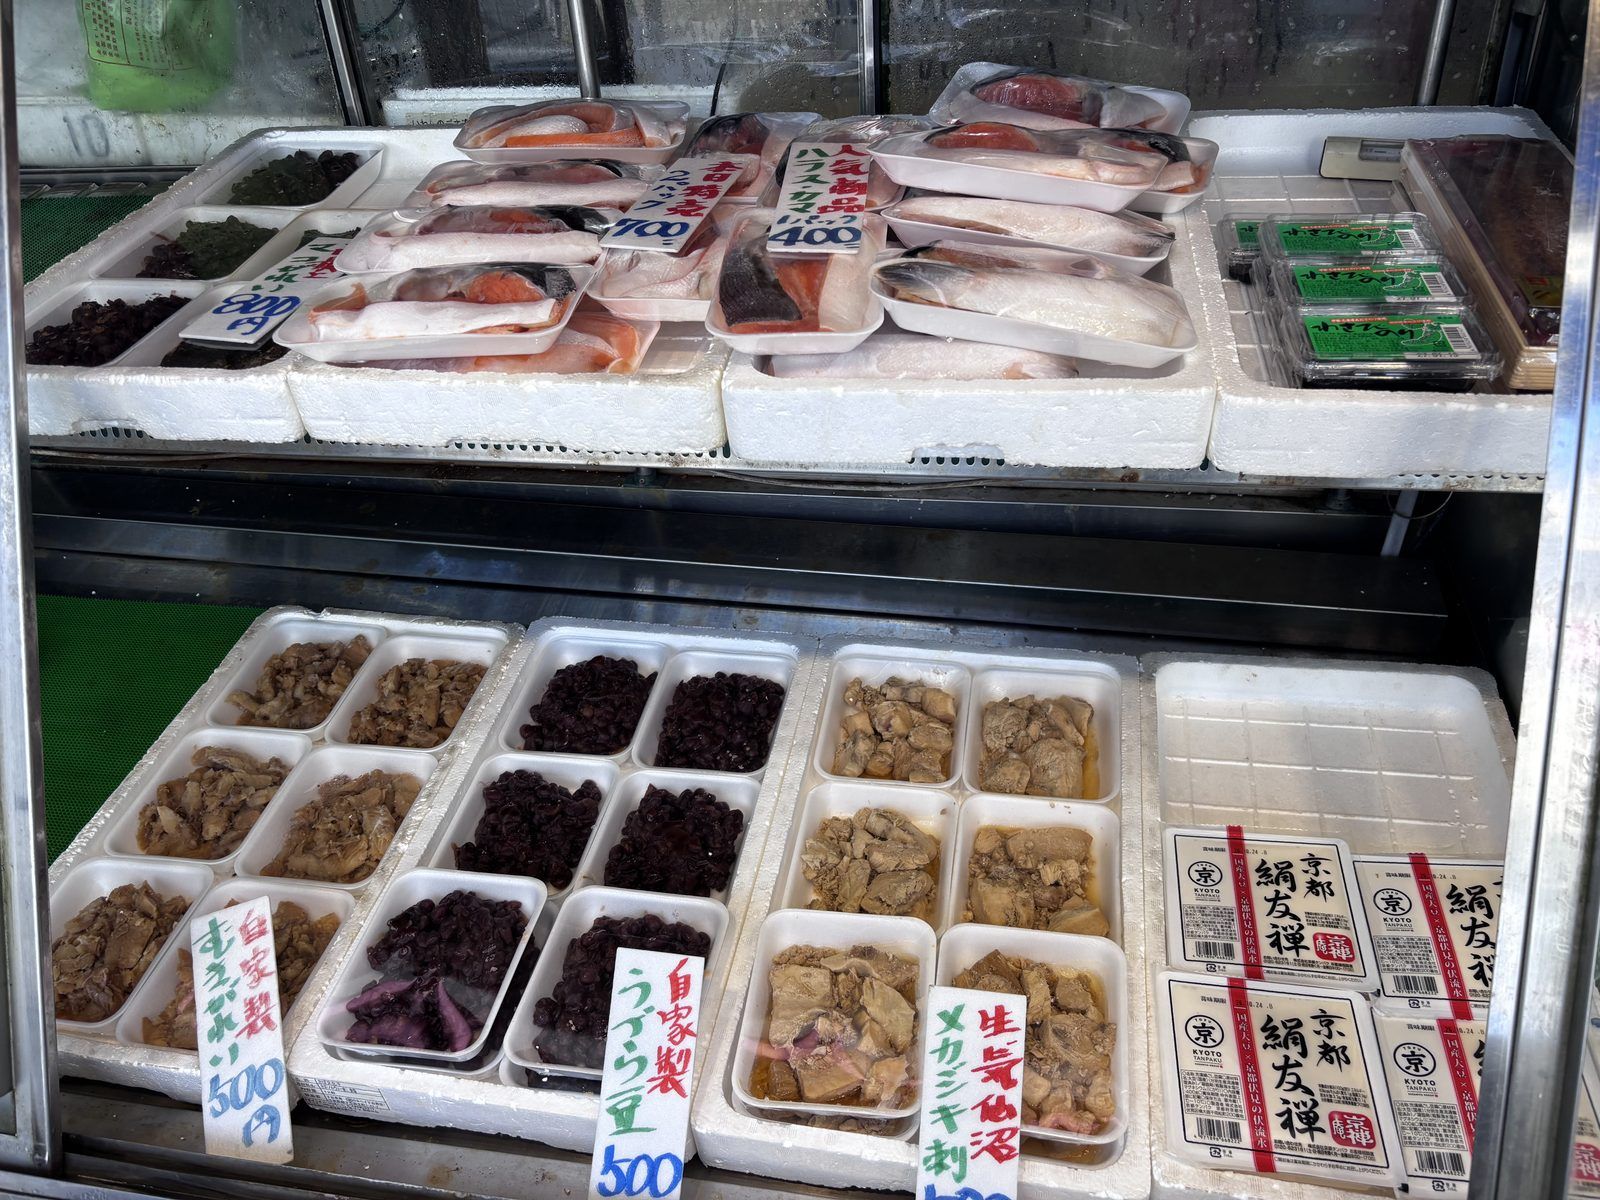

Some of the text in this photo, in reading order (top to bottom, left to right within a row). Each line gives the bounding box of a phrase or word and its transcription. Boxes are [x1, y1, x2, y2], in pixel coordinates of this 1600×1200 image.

[634, 170, 690, 211] 2パック
[817, 145, 870, 214] 人気商品
[612, 218, 690, 237] 700
[768, 226, 862, 246] 400
[1300, 271, 1395, 285] わさびのり
[212, 293, 300, 317] 800
[1311, 321, 1414, 339] わさびのり
[1194, 867, 1216, 883] 京
[1299, 852, 1335, 903] 京都
[1254, 858, 1310, 957] 絹友禅
[1381, 895, 1406, 912] 京
[235, 908, 278, 1039] 自家製
[646, 957, 697, 1099] 自家製
[1192, 1022, 1217, 1043] 京
[1310, 1008, 1351, 1073] 京都
[605, 968, 657, 1136] うづら豆
[1192, 1049, 1222, 1057] KYOTO
[1194, 1055, 1222, 1063] TANPAKU
[1401, 1051, 1429, 1073] 京
[209, 1057, 285, 1118] 500
[923, 1003, 968, 1184] メカジキ刺
[969, 1003, 1024, 1164] 生気仙沼
[1260, 1014, 1326, 1142] 絹友禅
[1404, 1078, 1436, 1086] KYOTO
[242, 1104, 281, 1148] 円
[597, 1144, 684, 1198] 500
